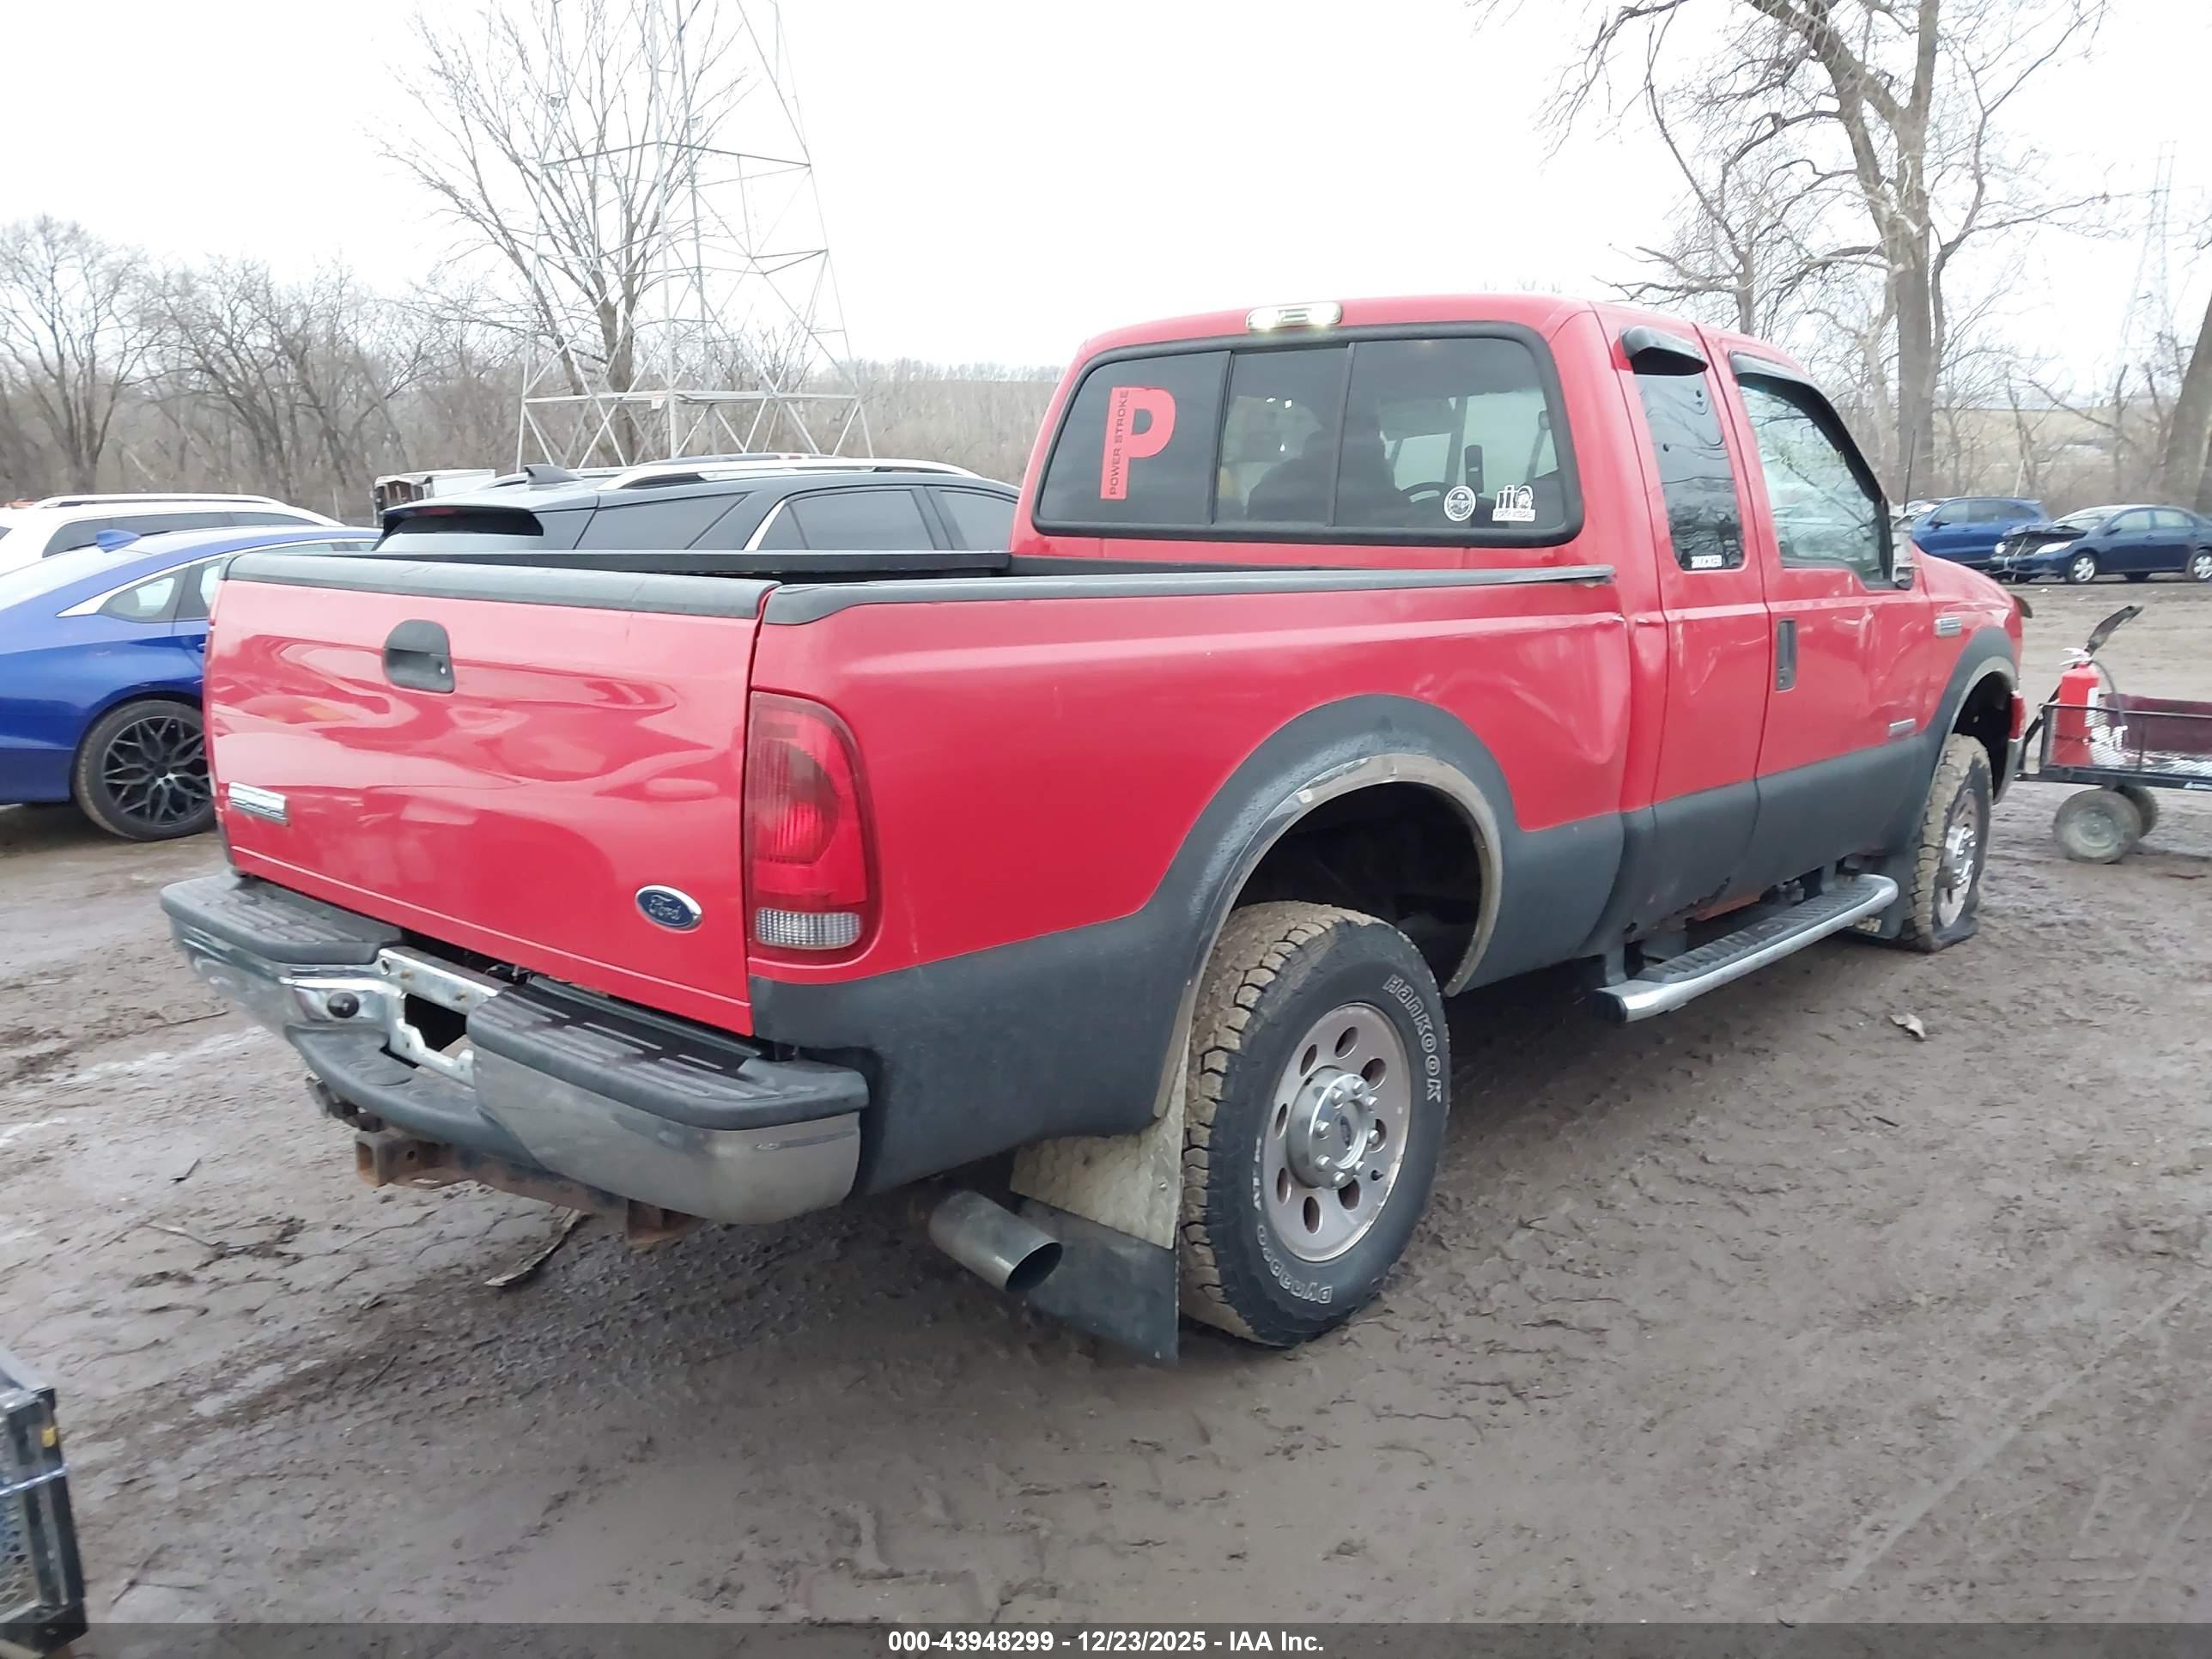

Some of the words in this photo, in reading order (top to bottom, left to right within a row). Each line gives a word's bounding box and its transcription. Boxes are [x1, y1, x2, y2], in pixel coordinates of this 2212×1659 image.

[1114, 390, 1129, 444] STROKE
[1100, 386, 1176, 500] P
[1109, 447, 1121, 495] POWER
[648, 894, 683, 921] Ford
